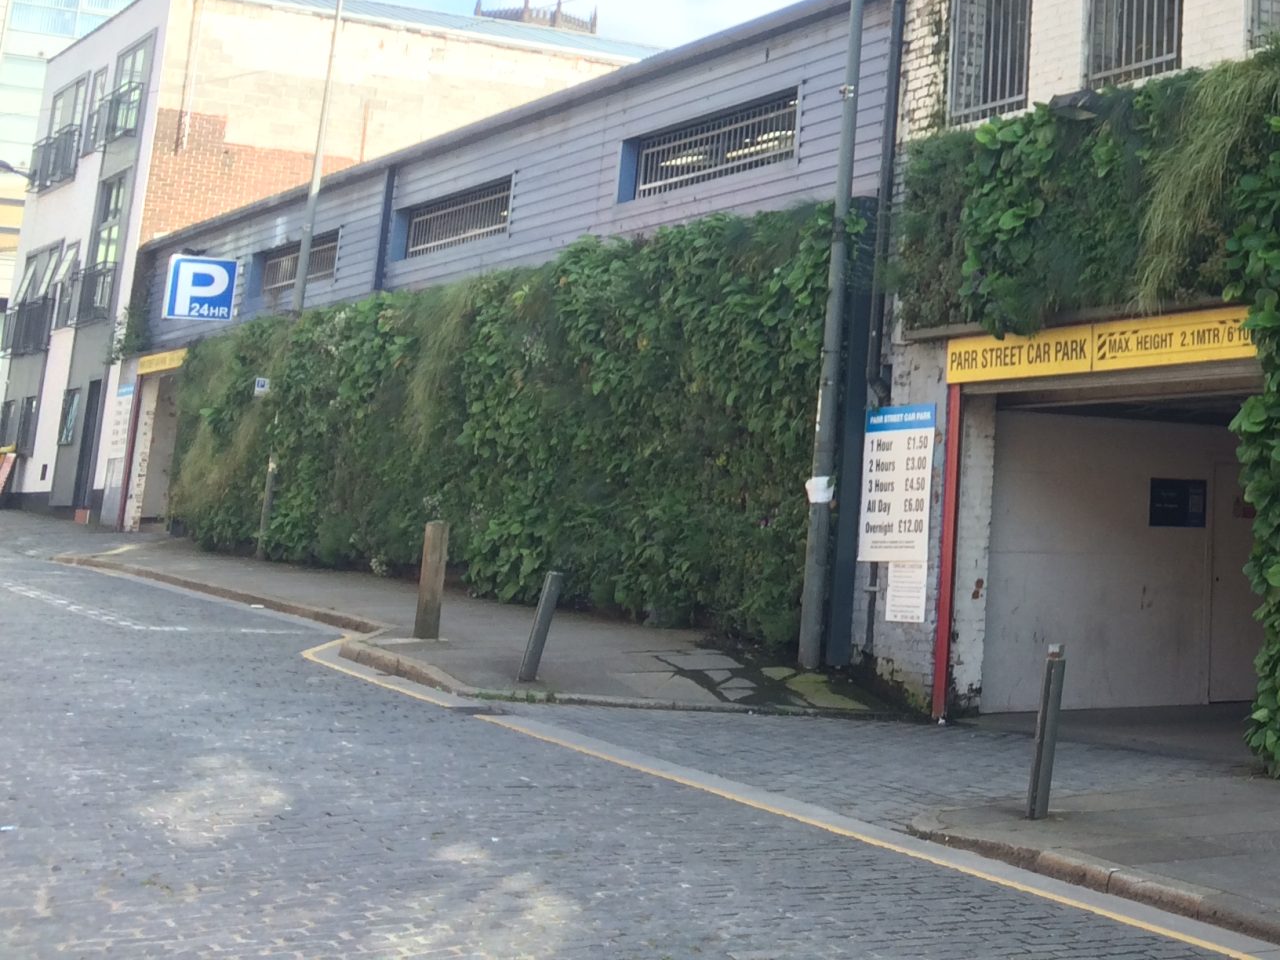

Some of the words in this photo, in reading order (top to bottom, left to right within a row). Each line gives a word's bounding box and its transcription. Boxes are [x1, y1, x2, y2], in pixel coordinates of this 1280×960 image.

[174, 262, 229, 316] P
[190, 303, 228, 317] 24HR
[1108, 338, 1133, 354] MAX.
[1136, 332, 1174, 352] HEIGHT
[950, 350, 978, 371] PARR
[981, 345, 1024, 369] STREET
[1027, 342, 1051, 364] CAR
[1054, 338, 1087, 362] PARK
[904, 412, 916, 422] CAR
[870, 439, 874, 452] 1
[876, 438, 893, 452] Hour
[906, 435, 928, 450] £1.50
[868, 458, 874, 473] 2
[876, 458, 896, 472] Hours
[906, 456, 927, 471] £3.00
[868, 479, 873, 494] 3
[874, 479, 895, 493] Hours
[904, 476, 926, 492] £4.50
[866, 499, 876, 513] All
[878, 499, 891, 516] Day
[904, 498, 925, 513] £6.00
[865, 521, 894, 536] Overnight
[898, 519, 924, 534] £12.00
